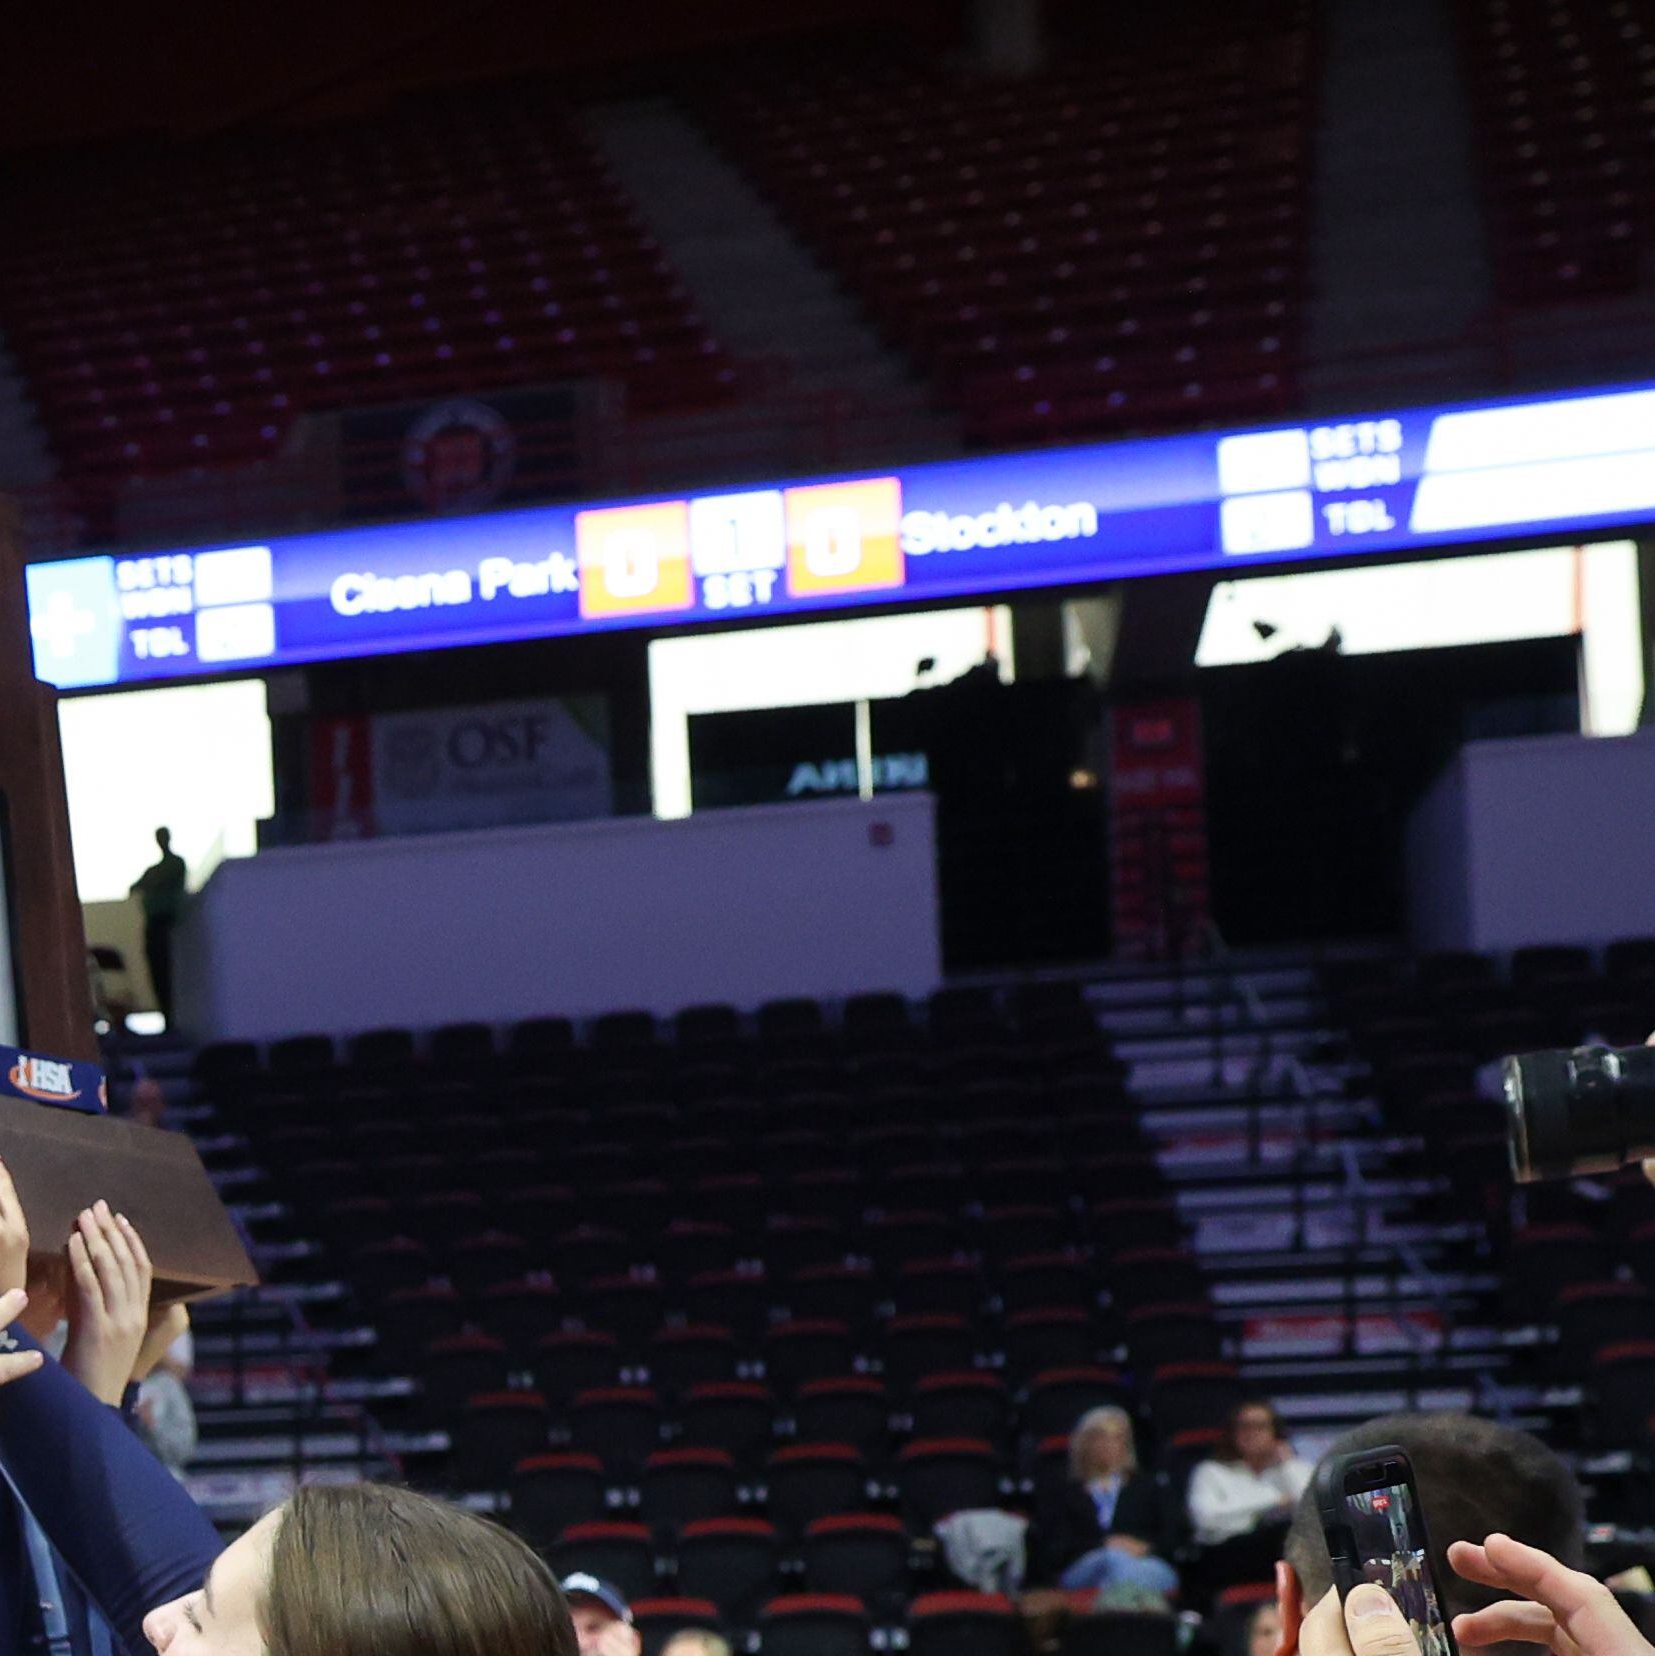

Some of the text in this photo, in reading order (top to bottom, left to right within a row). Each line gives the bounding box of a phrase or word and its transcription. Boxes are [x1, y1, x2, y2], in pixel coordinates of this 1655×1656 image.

[1310, 420, 1402, 459] SETS
[805, 506, 862, 576] 0
[900, 500, 1098, 555] Stockton
[116, 553, 194, 591] SETS
[478, 553, 580, 597] Park
[604, 529, 658, 598] 0
[705, 569, 775, 608] SET
[447, 715, 549, 767] OSF
[17, 1053, 74, 1095] IHSA
